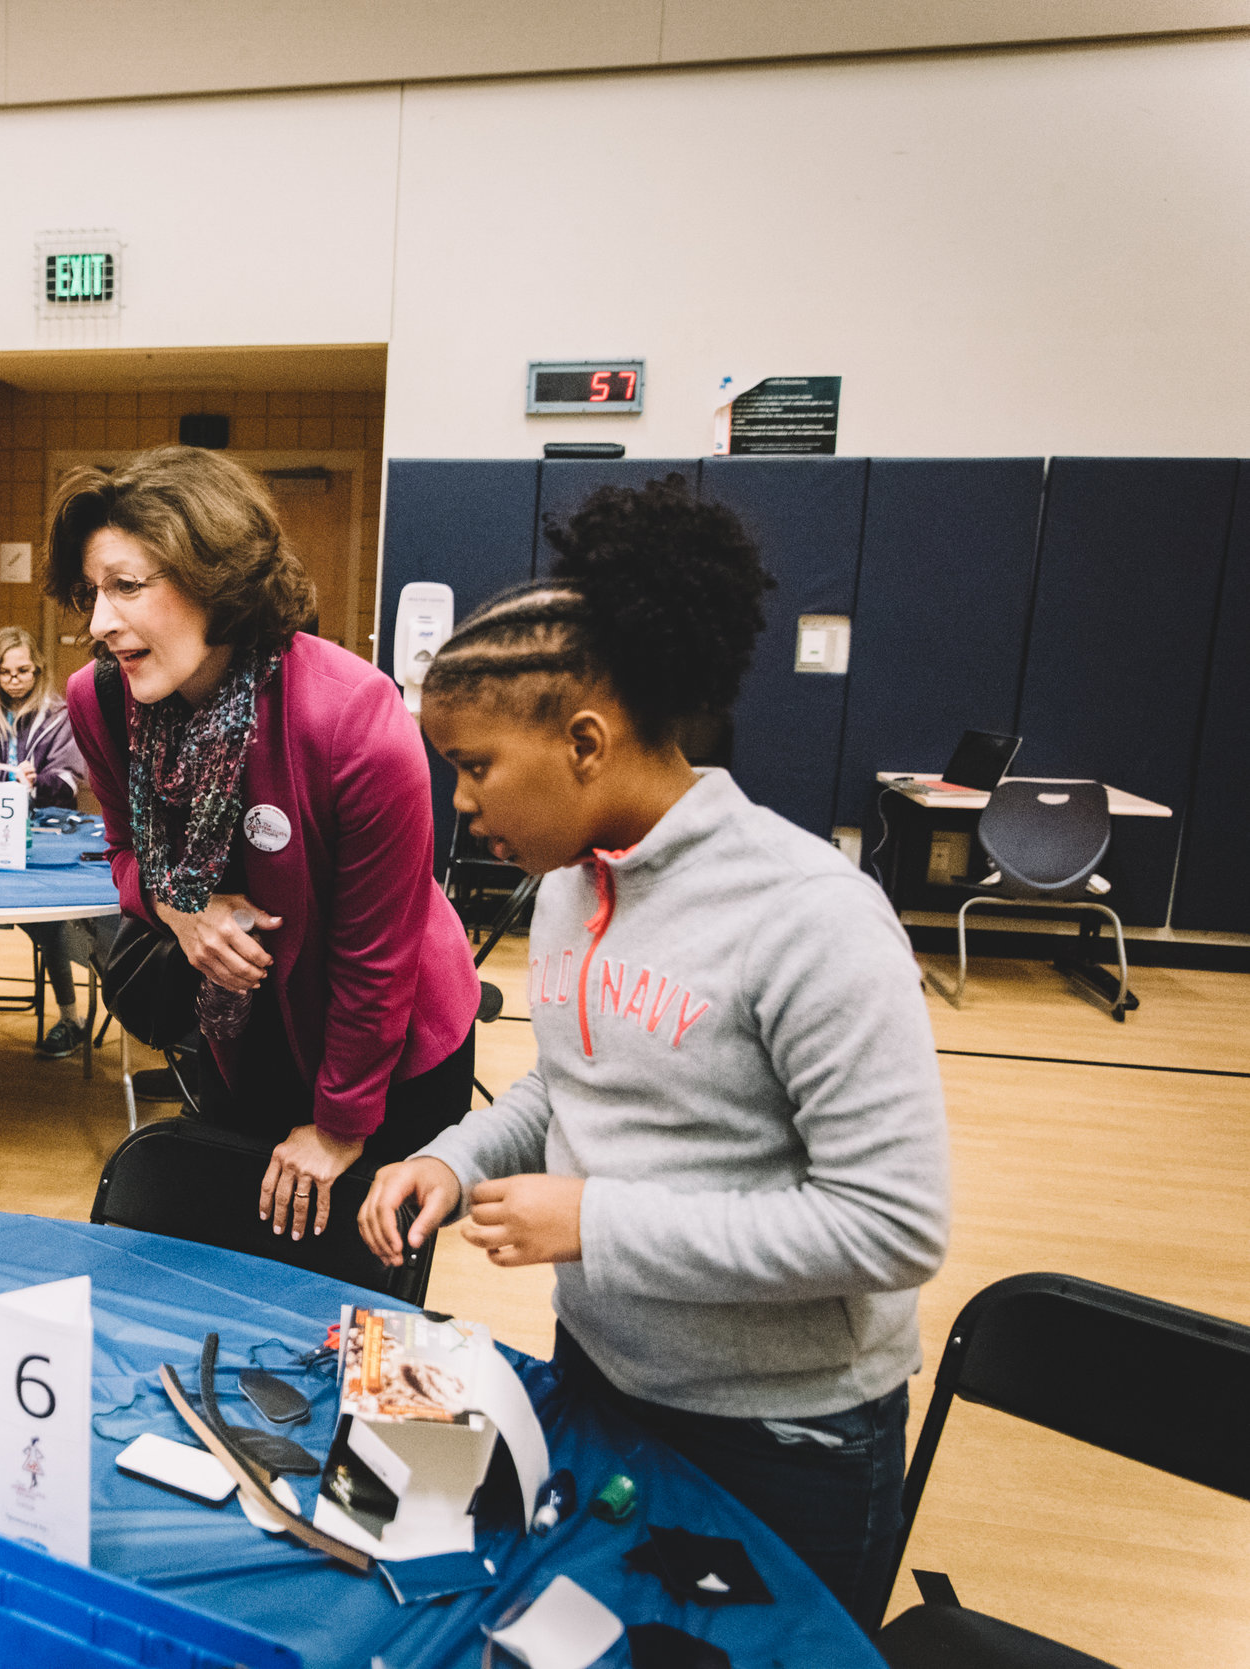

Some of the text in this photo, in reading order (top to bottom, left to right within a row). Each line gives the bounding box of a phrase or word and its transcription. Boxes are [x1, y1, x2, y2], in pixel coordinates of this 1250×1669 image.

[55, 254, 105, 297] EXIT
[590, 371, 637, 402] 57
[0, 797, 15, 820] 5
[601, 960, 710, 1047] NAVY
[15, 1354, 56, 1419] 6
